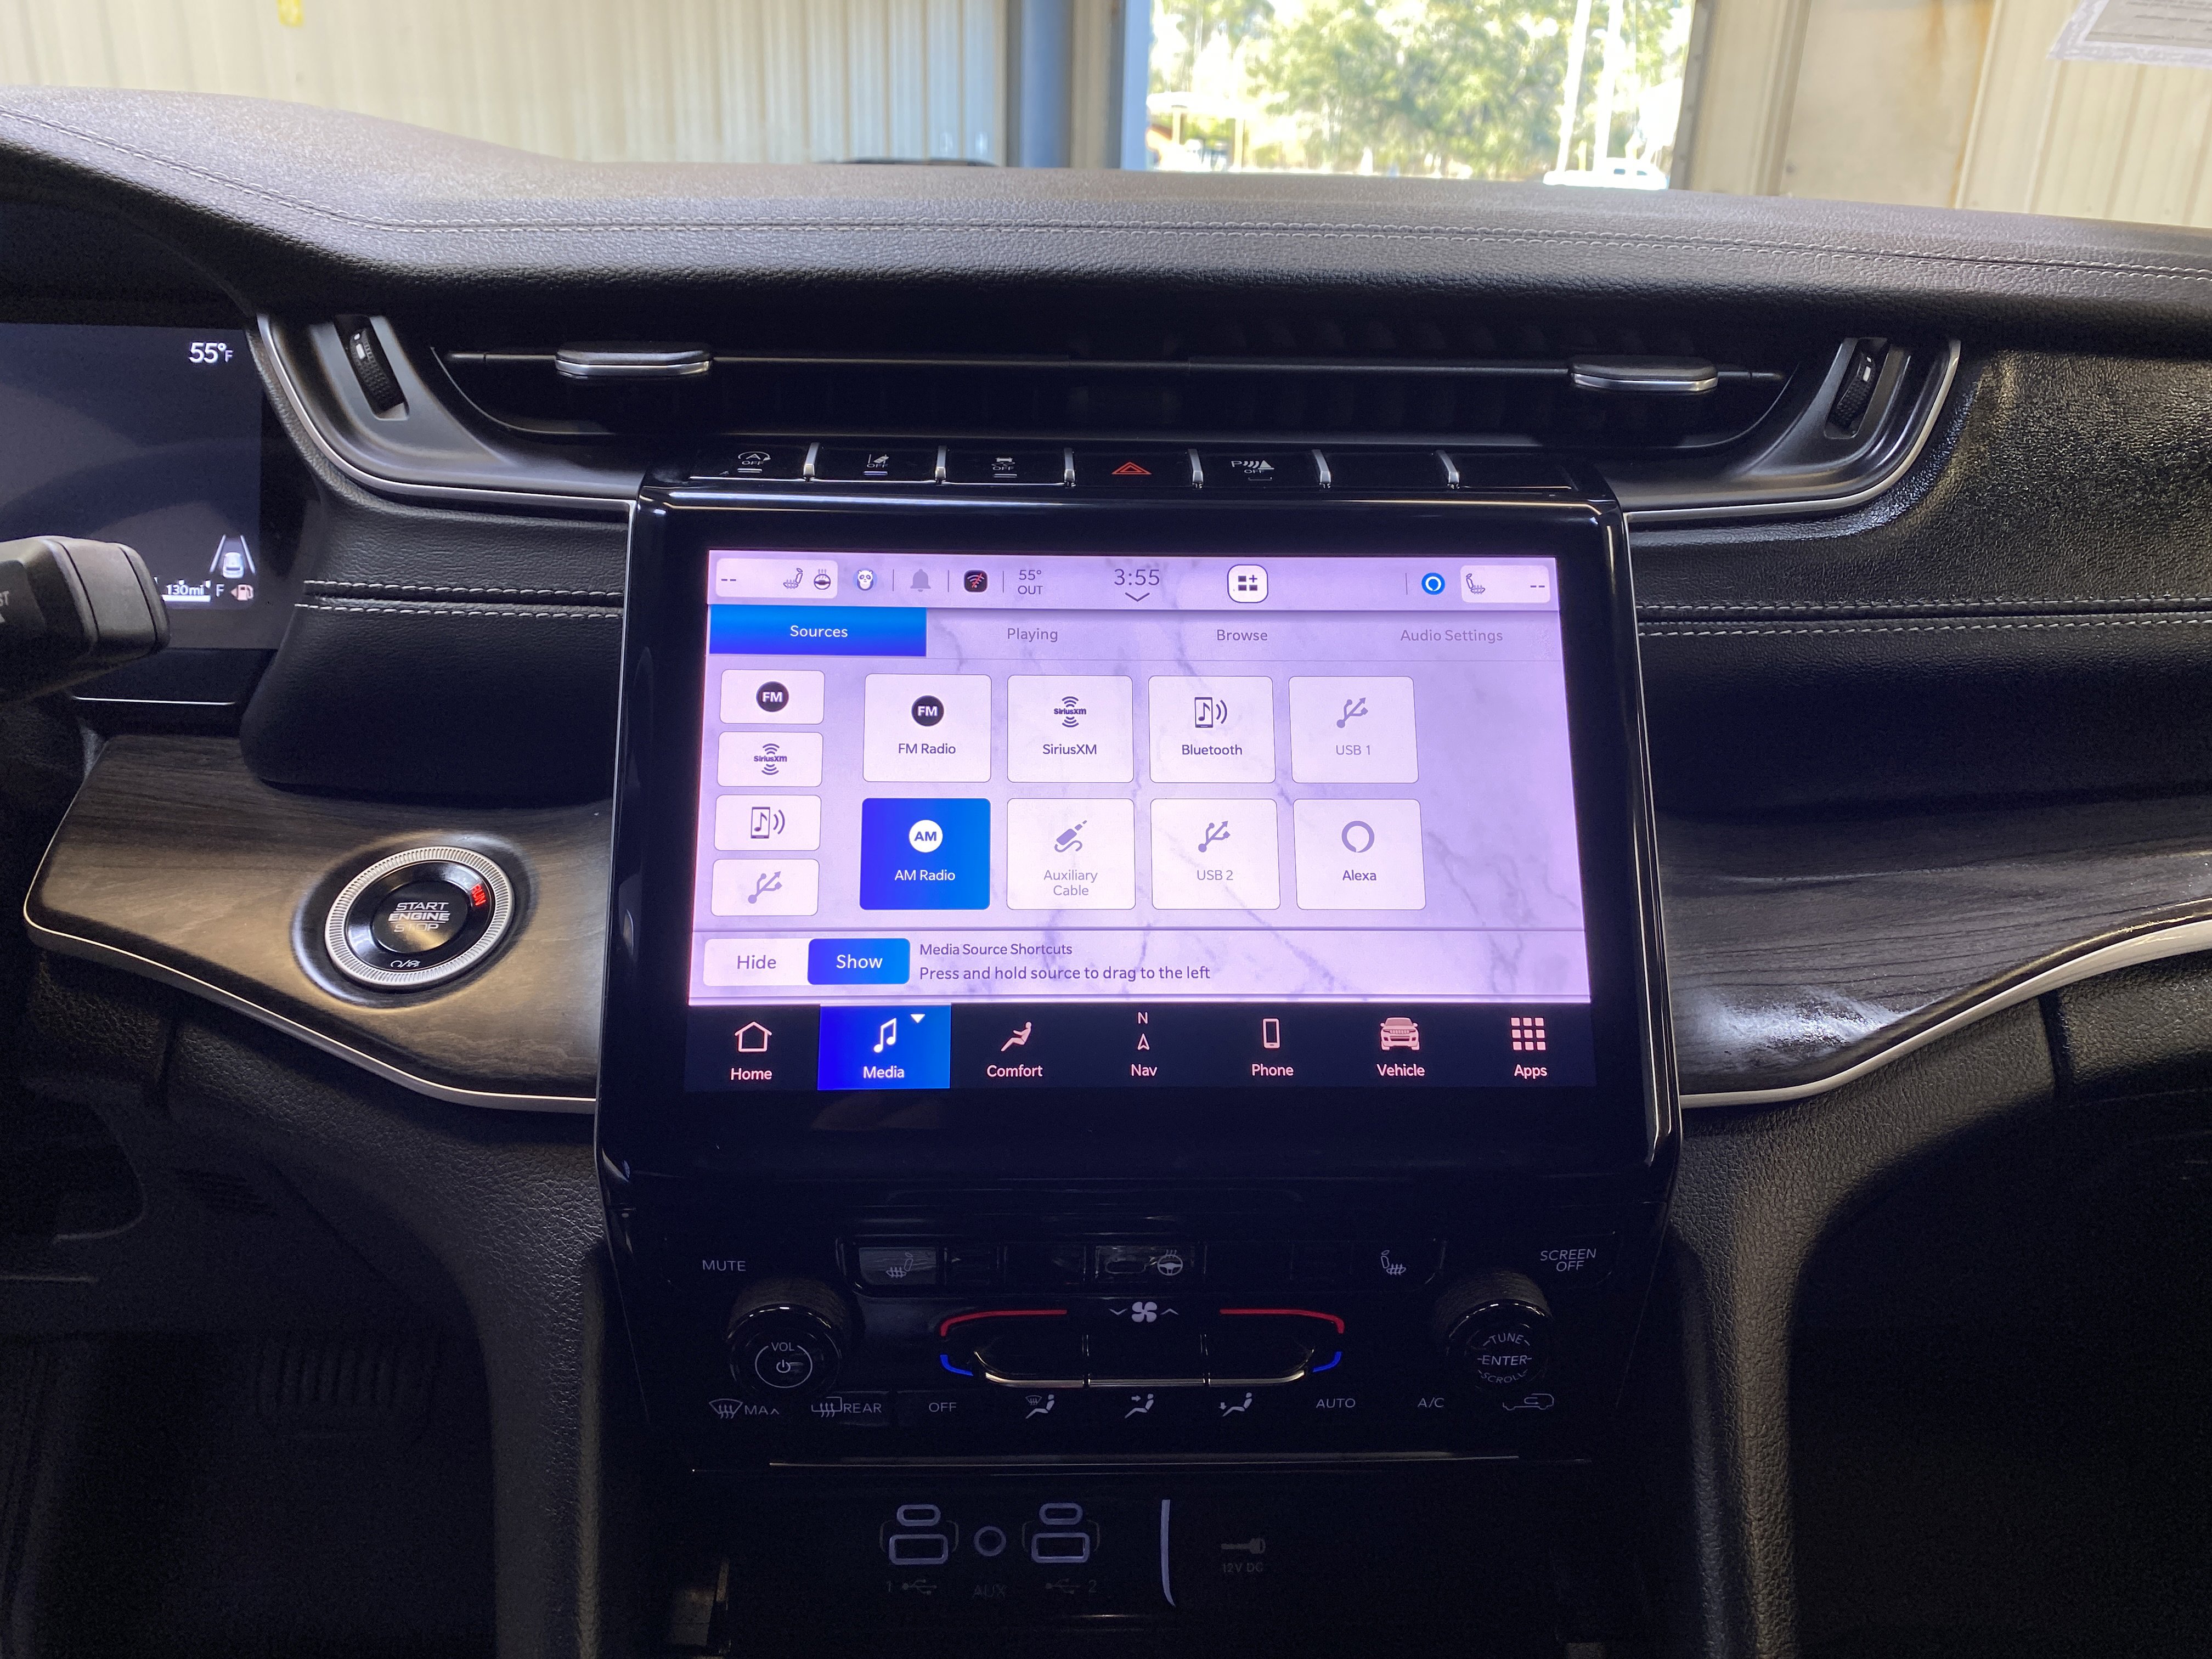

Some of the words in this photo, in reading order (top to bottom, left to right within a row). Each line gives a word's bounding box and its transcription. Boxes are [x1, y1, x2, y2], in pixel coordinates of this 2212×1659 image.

[1018, 569, 1042, 580] 55°
[1114, 569, 1160, 586] 3:55
[216, 584, 224, 597] F
[1018, 585, 1043, 595] OUT
[790, 625, 848, 638] Sources
[1007, 627, 1058, 643] Playing
[1216, 629, 1268, 641] Browse
[1401, 629, 1441, 642] Audio
[1445, 629, 1503, 645] Settings
[762, 692, 783, 703] FM
[917, 706, 938, 716] FM
[898, 744, 918, 754] FM
[921, 743, 956, 754] Radio
[1042, 744, 1097, 755] SiriusXM
[1182, 744, 1243, 755] Bluetooth
[1336, 744, 1362, 755] USB
[1366, 744, 1371, 755] 1
[914, 831, 937, 842] AM
[894, 870, 917, 881] AM
[919, 870, 956, 881] Radio
[1043, 870, 1098, 883] Auxiliary
[1197, 870, 1223, 881] USB
[1226, 870, 1234, 881] 2
[1342, 870, 1377, 882] Alexa
[471, 884, 486, 906] RUN
[1053, 884, 1089, 896] Cable
[396, 902, 449, 911] START
[388, 913, 450, 922] ENGINE
[394, 923, 439, 932] STOP
[920, 943, 960, 955] Media
[962, 944, 1008, 955] Source
[1010, 943, 1073, 955] Shortcuts
[737, 955, 777, 970] Hide
[836, 955, 883, 970] Show
[920, 967, 960, 980] Press
[963, 967, 991, 980] and
[995, 967, 1027, 980] hold
[1030, 970, 1080, 980] source
[1084, 968, 1099, 980] to
[1103, 967, 1137, 983] drag
[1140, 968, 1155, 979] to
[1159, 967, 1183, 979] the
[1187, 966, 1210, 979] left
[1138, 1012, 1148, 1024] N
[731, 1068, 772, 1080] Home
[863, 1065, 905, 1079] Media
[987, 1064, 1043, 1077] Comfort
[1131, 1065, 1158, 1076] Nav
[1251, 1064, 1294, 1077] Phone
[1376, 1064, 1425, 1077] Vehicle
[1514, 1064, 1548, 1080] Apps
[1541, 1248, 1596, 1262] SCREEN
[702, 1260, 746, 1272] MUTE
[1556, 1261, 1584, 1272] OFF
[1489, 1333, 1523, 1344] TUNE
[771, 1342, 795, 1352] VOL
[1482, 1355, 1527, 1365] ENTER
[844, 1403, 882, 1414] REAR
[929, 1402, 957, 1413] OFF
[1316, 1397, 1356, 1409] AUTO
[1418, 1397, 1444, 1409] A/C
[1222, 1564, 1243, 1573] 12V
[1246, 1563, 1263, 1573] DC
[972, 1585, 1006, 1598] AUX
